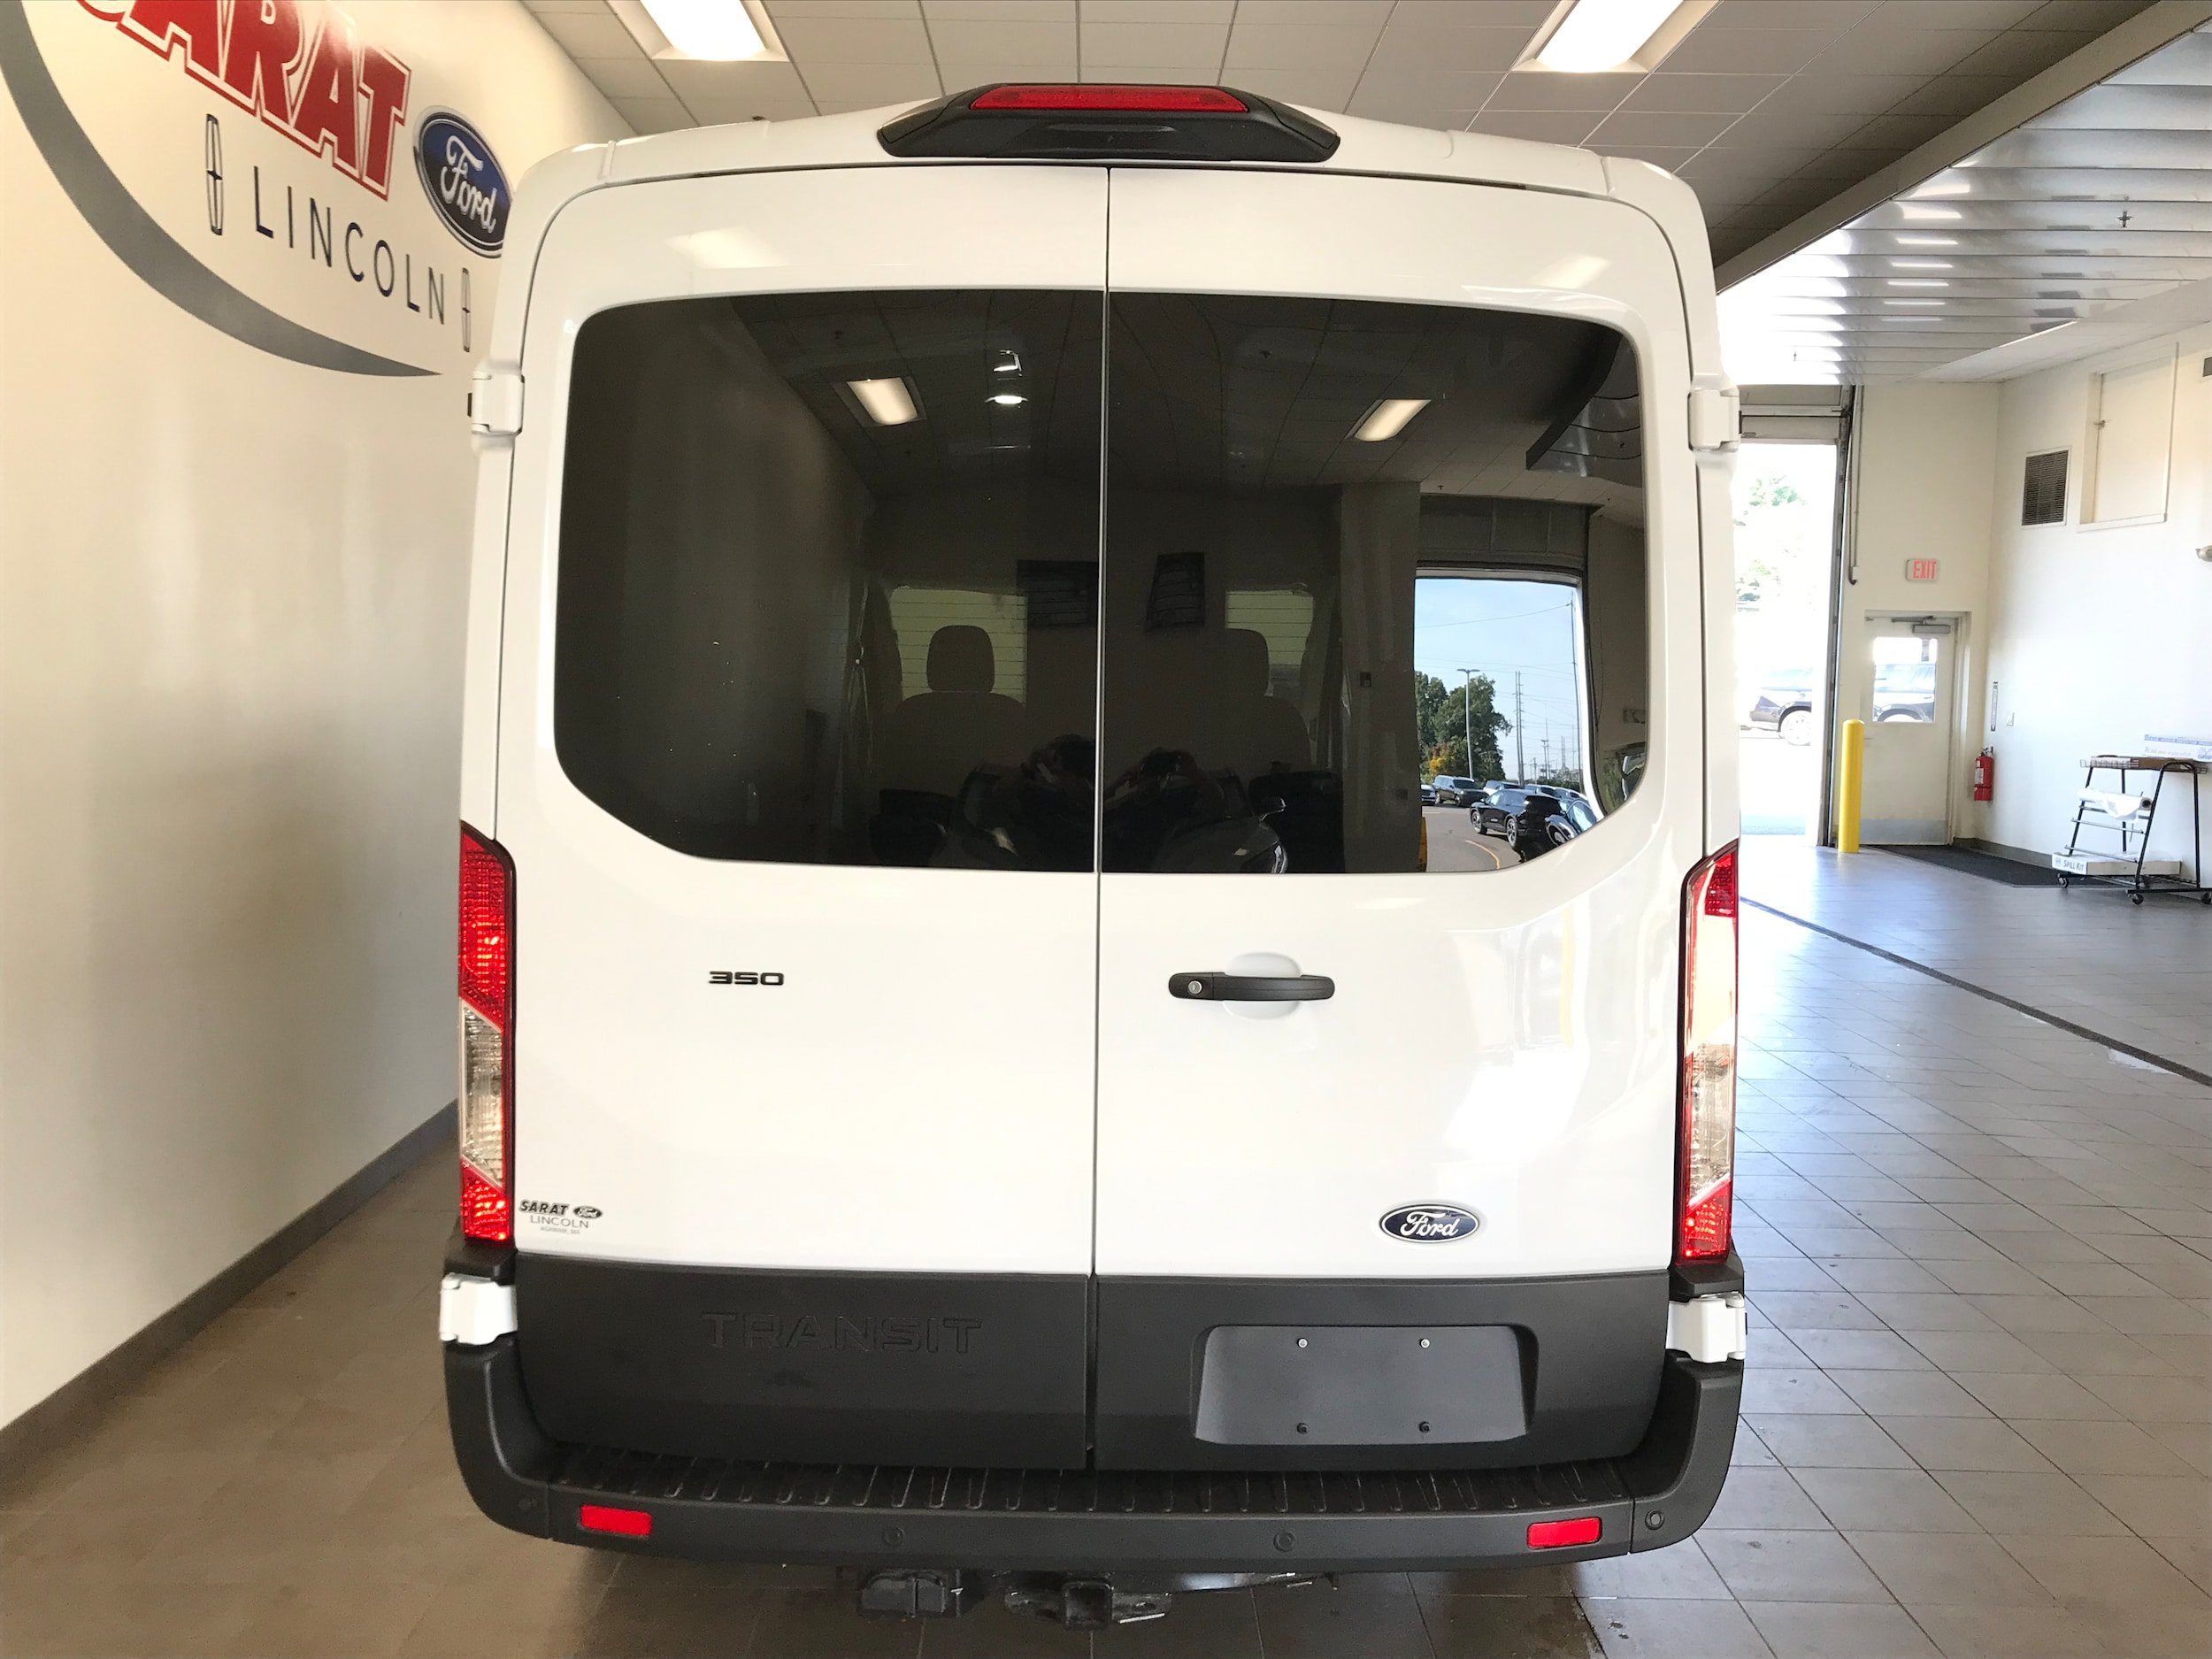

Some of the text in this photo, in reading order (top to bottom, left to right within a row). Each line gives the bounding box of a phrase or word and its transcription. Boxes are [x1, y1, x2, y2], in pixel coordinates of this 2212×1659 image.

[77, 0, 412, 202] RAT
[440, 134, 498, 234] Ford
[253, 165, 445, 326] LINCOLN
[1912, 559, 1937, 580] EXIT
[709, 971, 784, 986] 350
[518, 1200, 570, 1217] SARAT
[530, 1215, 589, 1229] LINCOLN
[1399, 1210, 1461, 1237] Ford
[701, 1310, 983, 1354] TRANSIT
